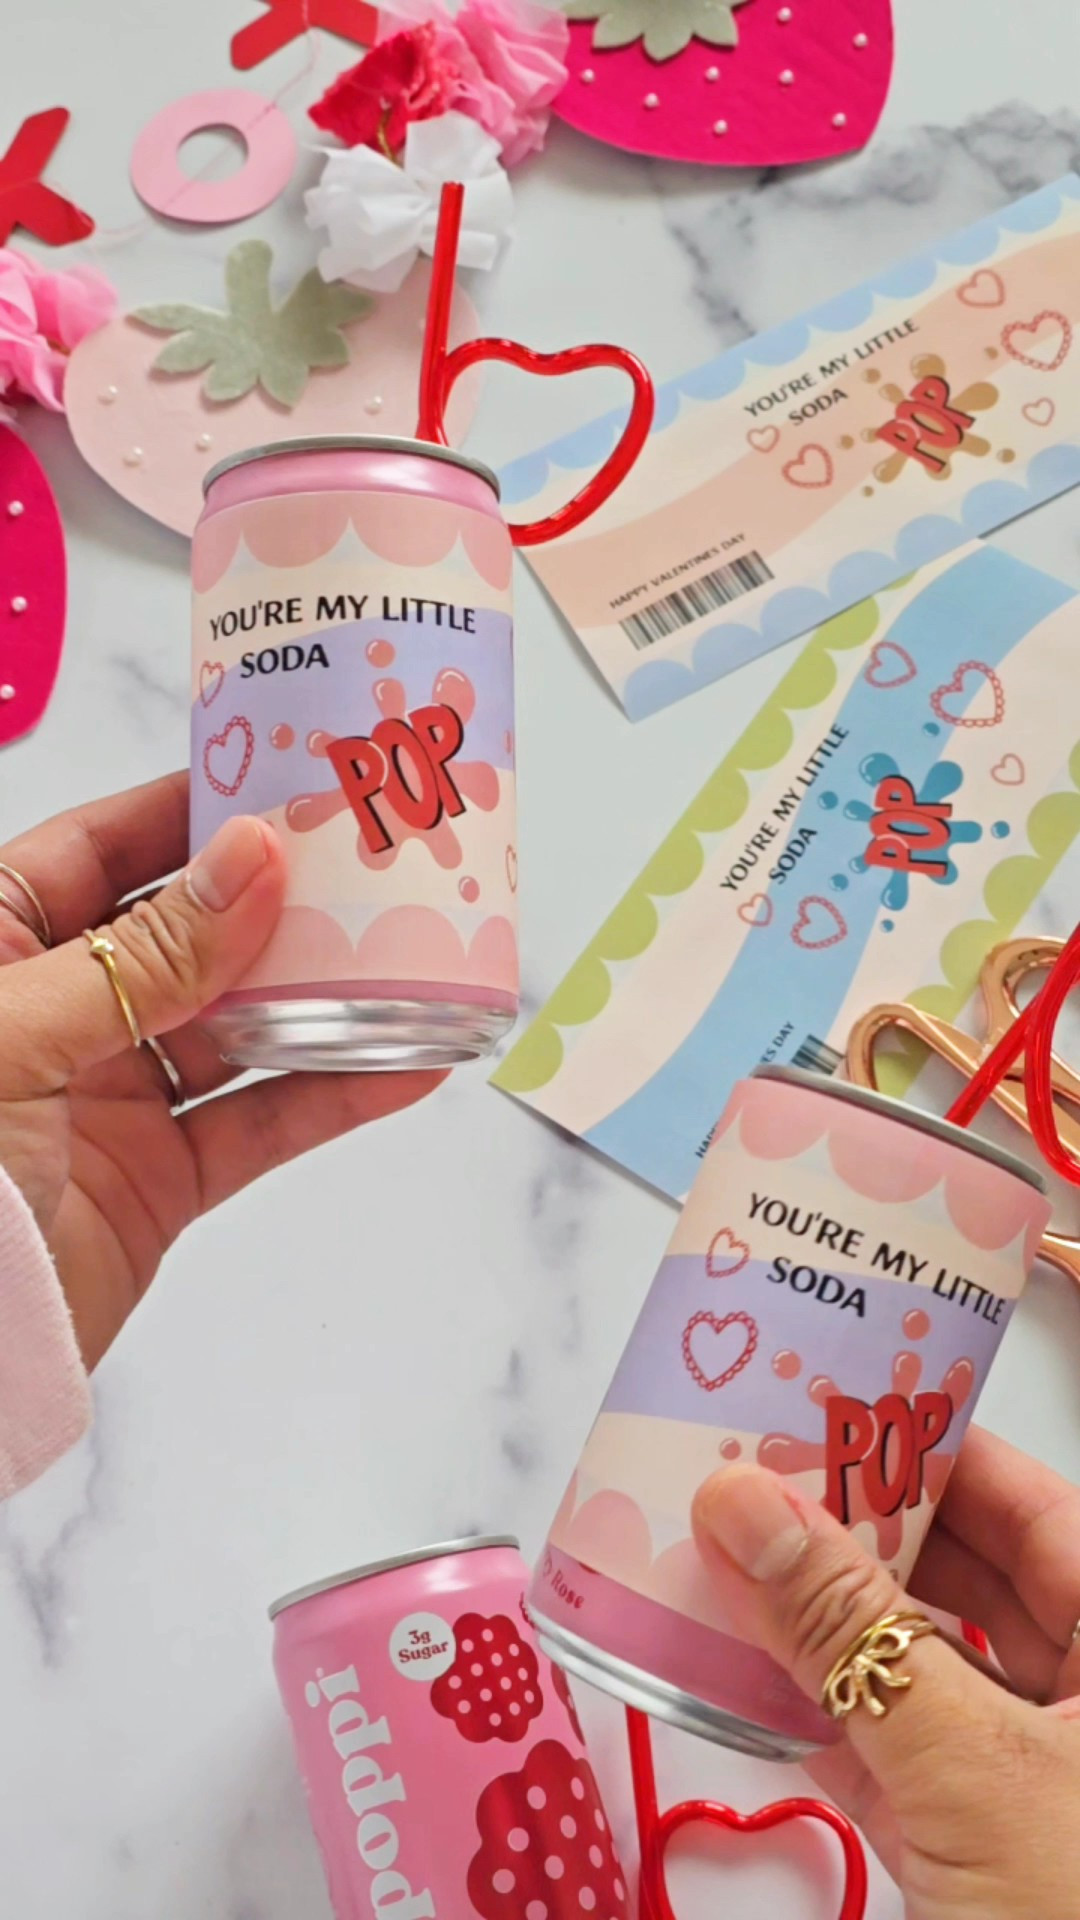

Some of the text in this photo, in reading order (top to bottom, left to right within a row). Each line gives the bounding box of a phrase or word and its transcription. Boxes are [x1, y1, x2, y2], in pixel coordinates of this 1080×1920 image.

[743, 318, 920, 419] YOU'RE MY LITTLE
[788, 387, 848, 426] SODA
[875, 375, 976, 474] POP
[609, 533, 746, 609] HAPPY VALENTINES DAY
[210, 596, 477, 641] YOU'RE MY LITTLE
[240, 643, 330, 679] SODA
[326, 703, 466, 853] POP
[719, 723, 849, 894] YOU'RE MY LITTLE
[768, 826, 818, 885] SODA
[864, 774, 952, 878] POP
[772, 1021, 795, 1048] DAY
[747, 1192, 1008, 1326] YOU'RE MY LITTLE
[766, 1256, 867, 1318] SODA
[825, 1391, 953, 1525] POP
[551, 1570, 584, 1609] Rose
[398, 1641, 449, 1663] Sugar
[408, 1630, 431, 1645] 3g
[305, 1665, 436, 1920] poppi
